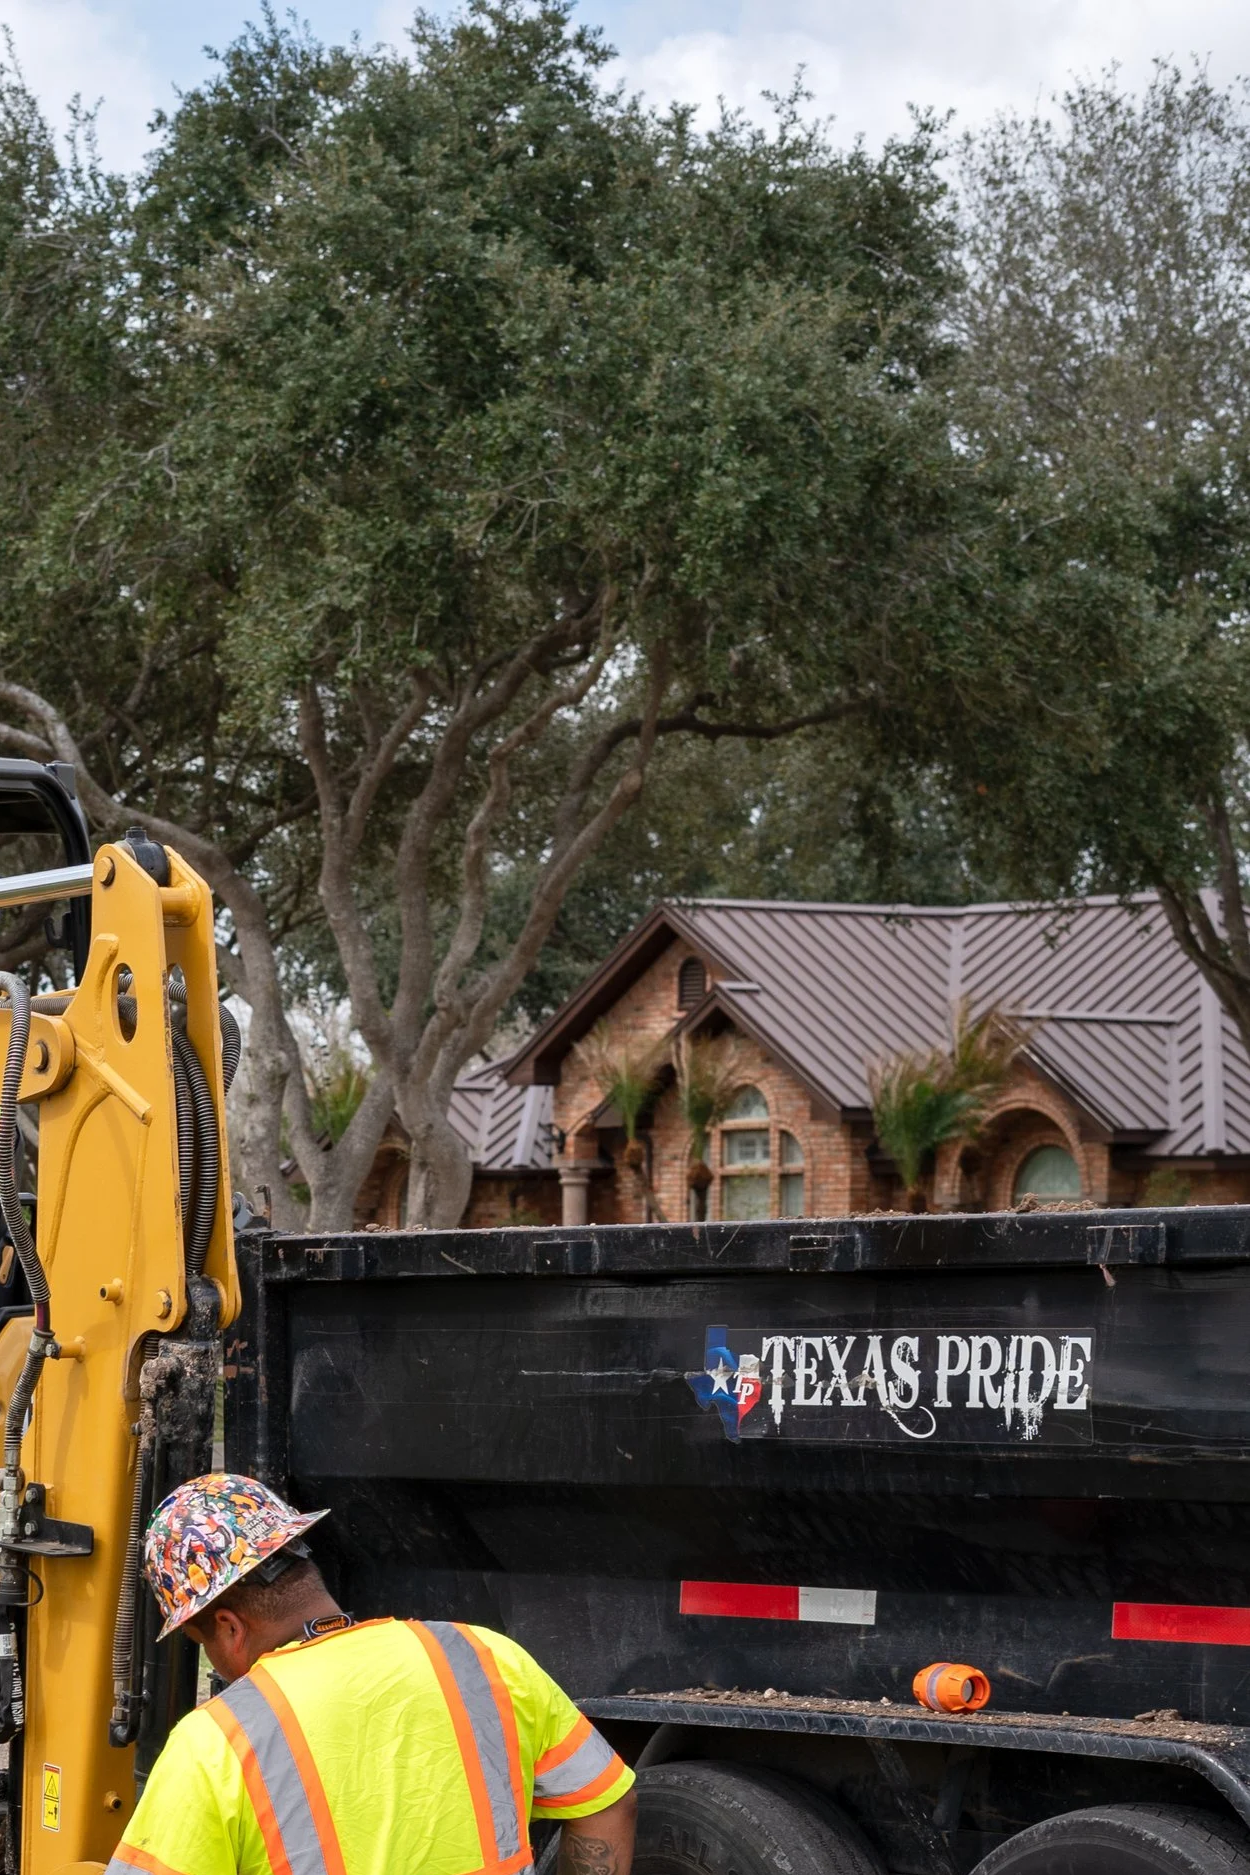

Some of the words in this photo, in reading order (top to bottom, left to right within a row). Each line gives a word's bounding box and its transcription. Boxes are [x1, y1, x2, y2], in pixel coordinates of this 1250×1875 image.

[761, 1334, 936, 1438] TEXAS
[933, 1334, 1092, 1439] PRIDE
[658, 1822, 716, 1875] ALL
